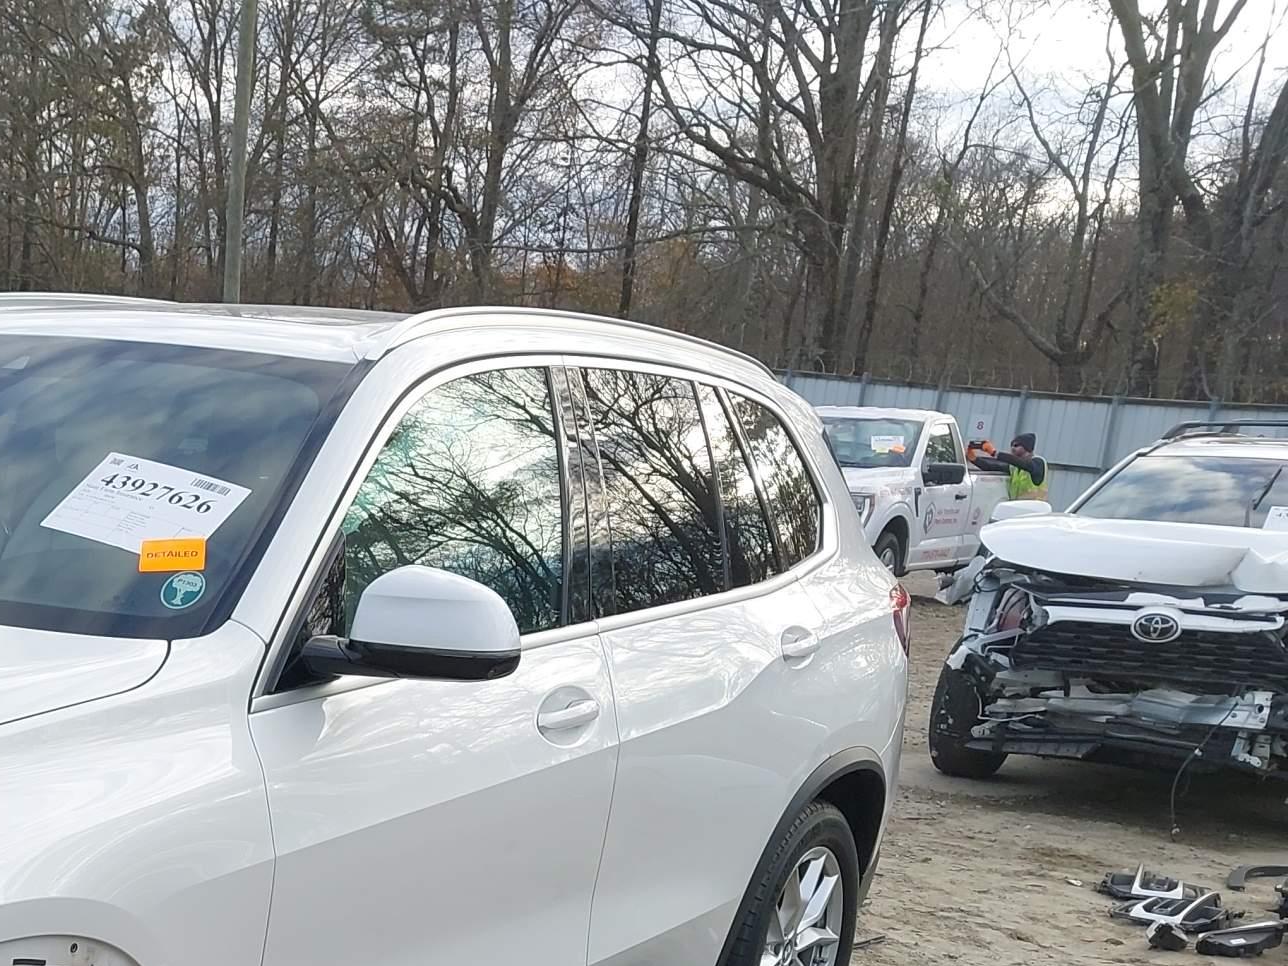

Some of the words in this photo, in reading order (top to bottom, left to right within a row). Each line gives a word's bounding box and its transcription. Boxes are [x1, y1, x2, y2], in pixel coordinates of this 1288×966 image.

[976, 420, 985, 431] 8
[100, 473, 216, 514] 43927626
[146, 550, 199, 559] DETAILED
